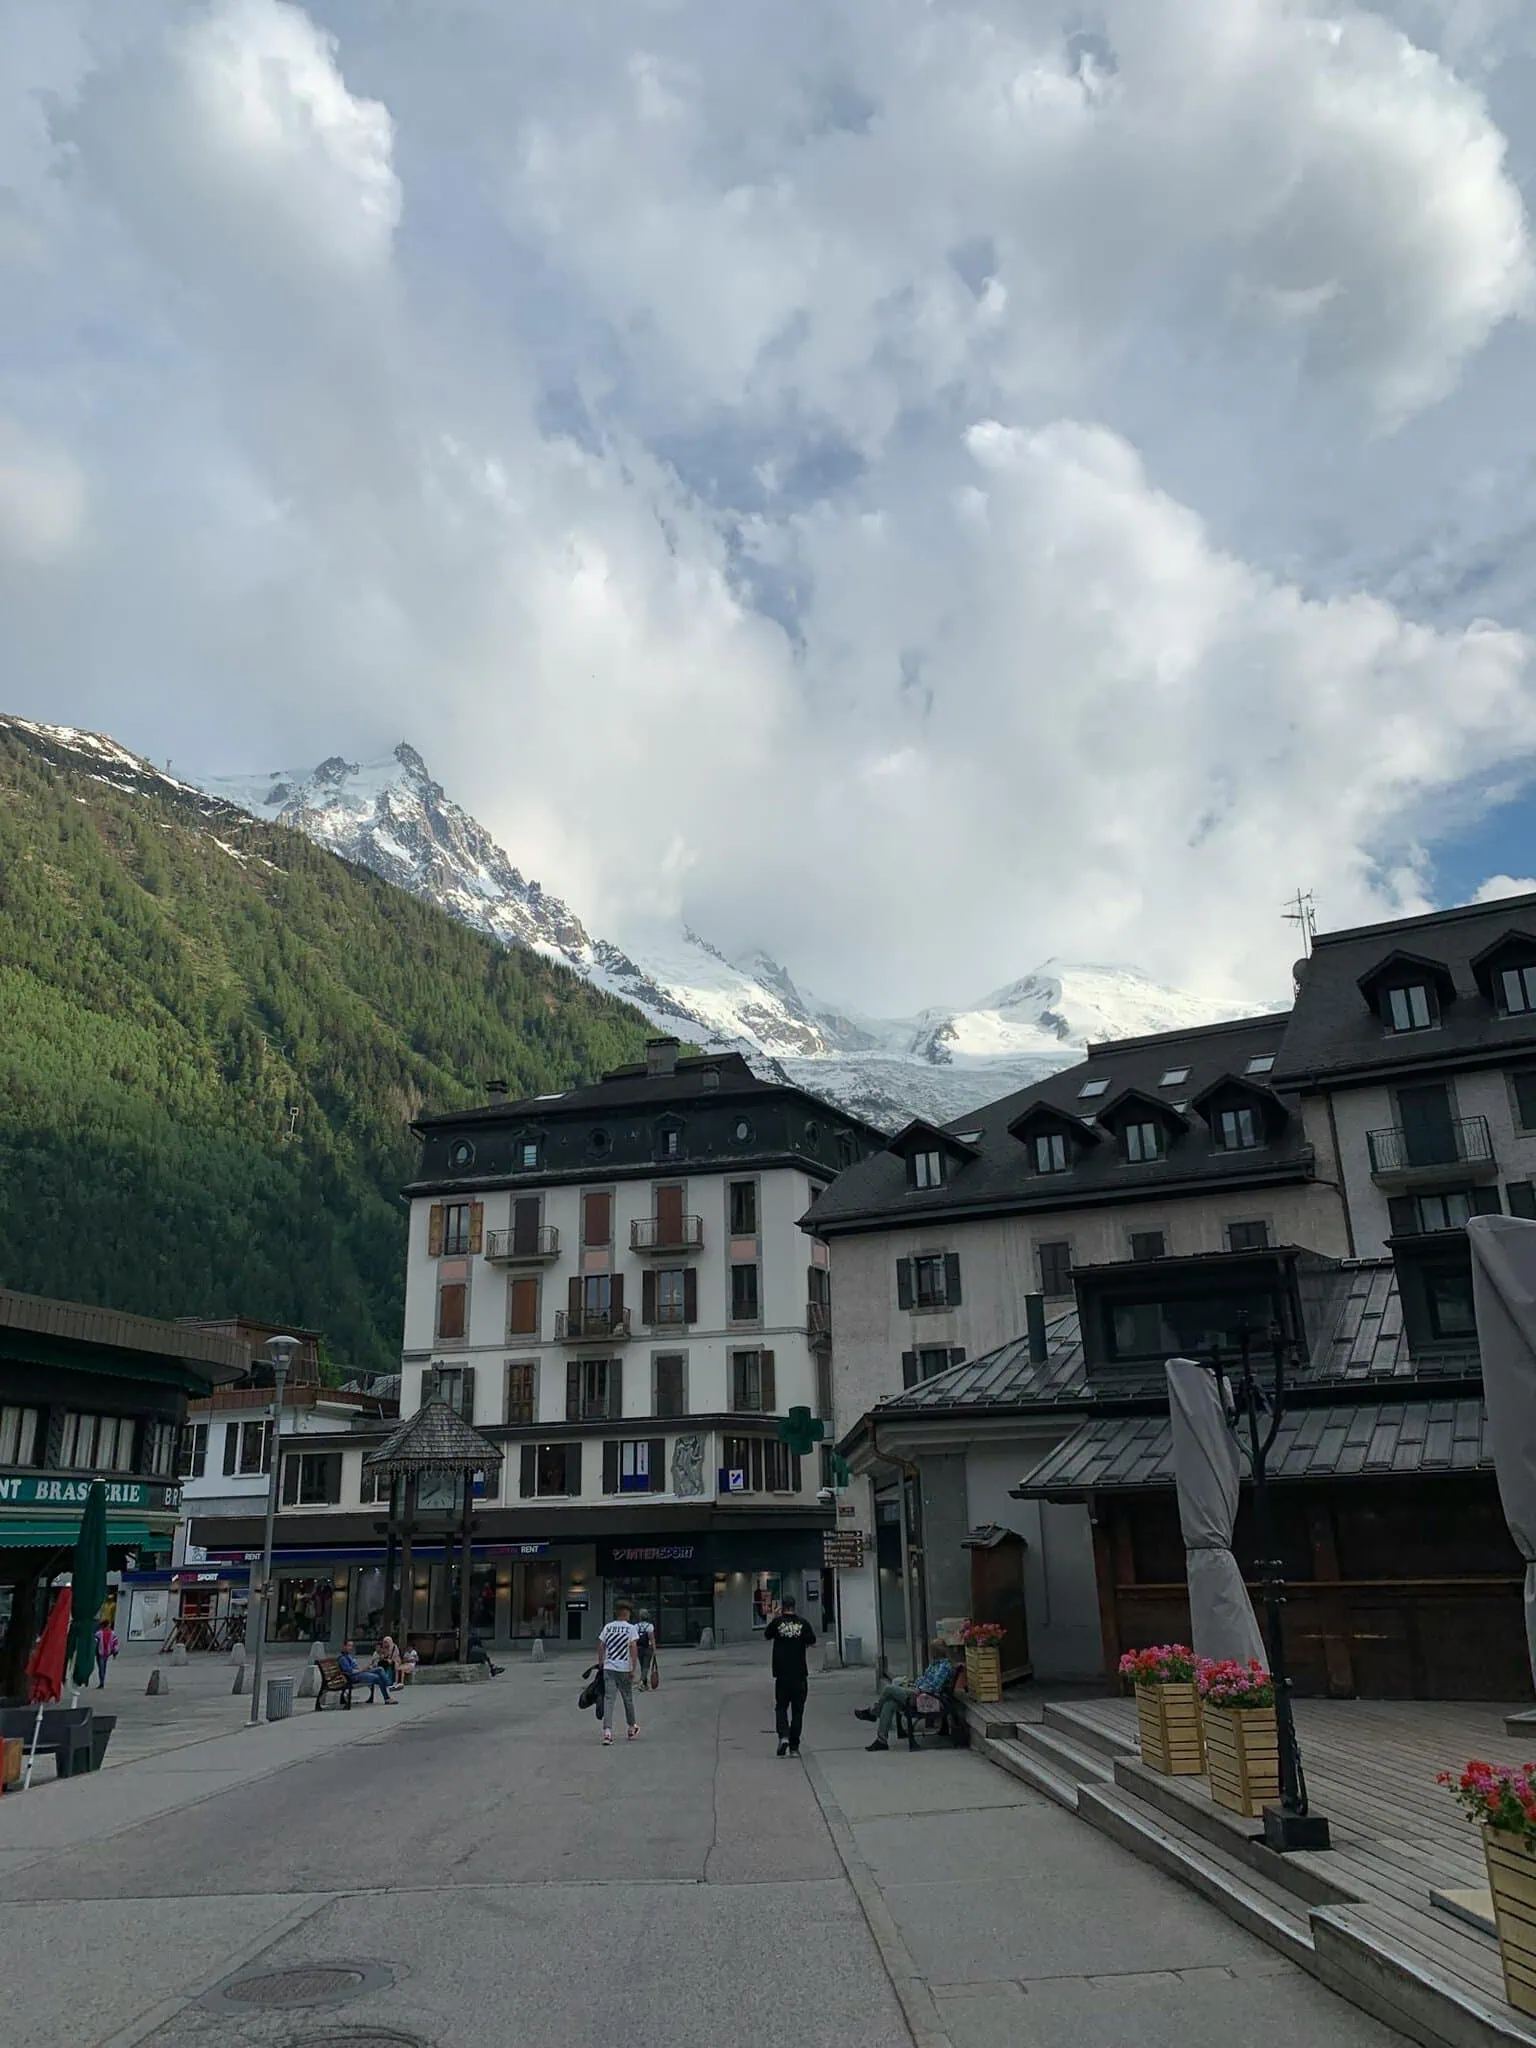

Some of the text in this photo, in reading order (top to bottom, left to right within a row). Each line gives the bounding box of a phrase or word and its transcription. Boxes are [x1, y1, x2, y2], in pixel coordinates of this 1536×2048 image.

[35, 1481, 140, 1503] BRASERIE
[244, 1553, 261, 1561] RENT
[626, 1545, 694, 1560] INTERSPORT
[606, 1625, 631, 1634] WHITE
